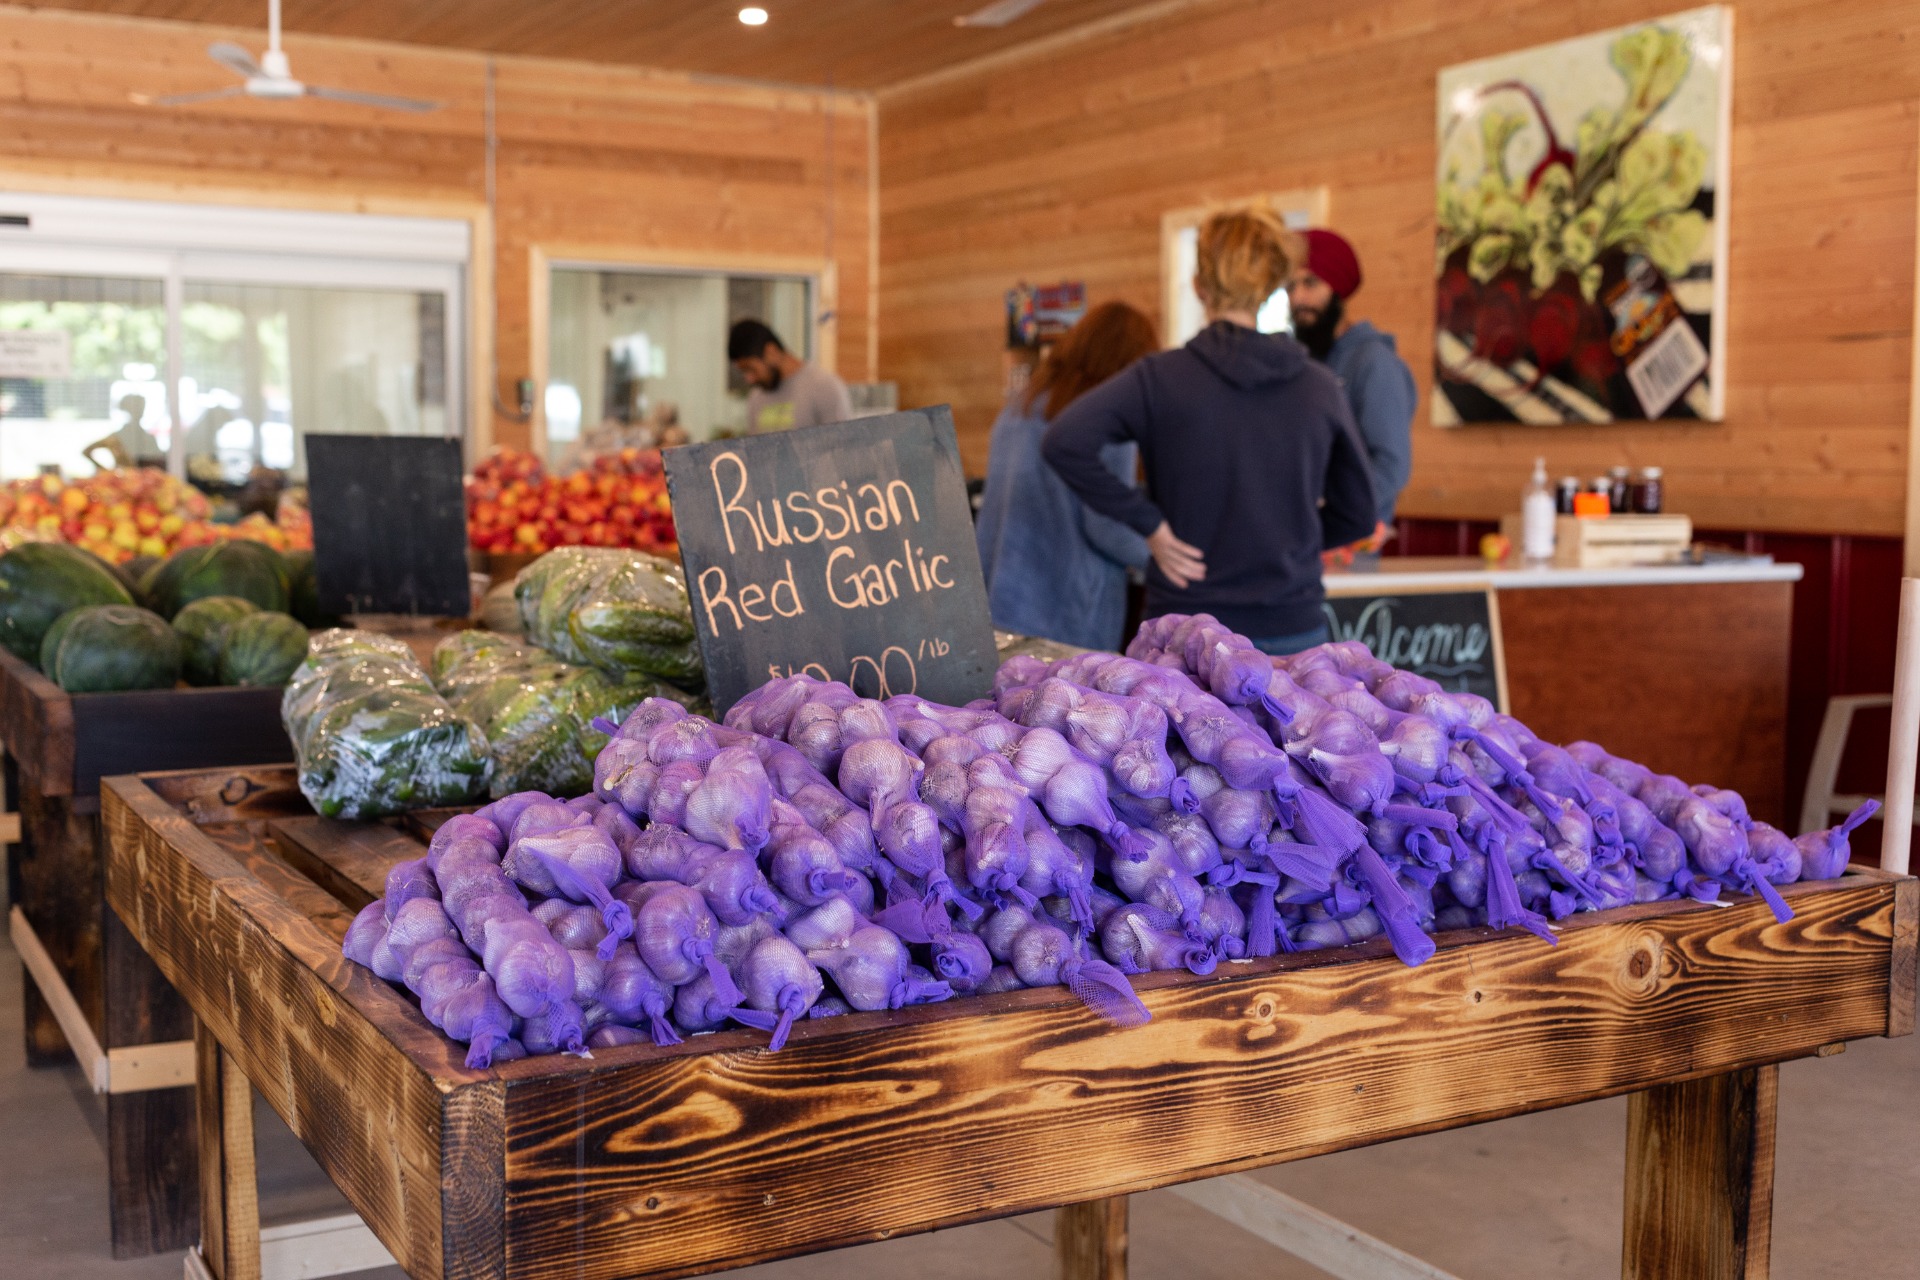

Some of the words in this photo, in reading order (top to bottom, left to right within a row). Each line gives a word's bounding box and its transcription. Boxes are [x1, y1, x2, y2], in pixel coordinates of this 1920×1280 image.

[709, 452, 920, 554] Russian
[698, 559, 805, 638] Red
[826, 539, 955, 609] Garlic
